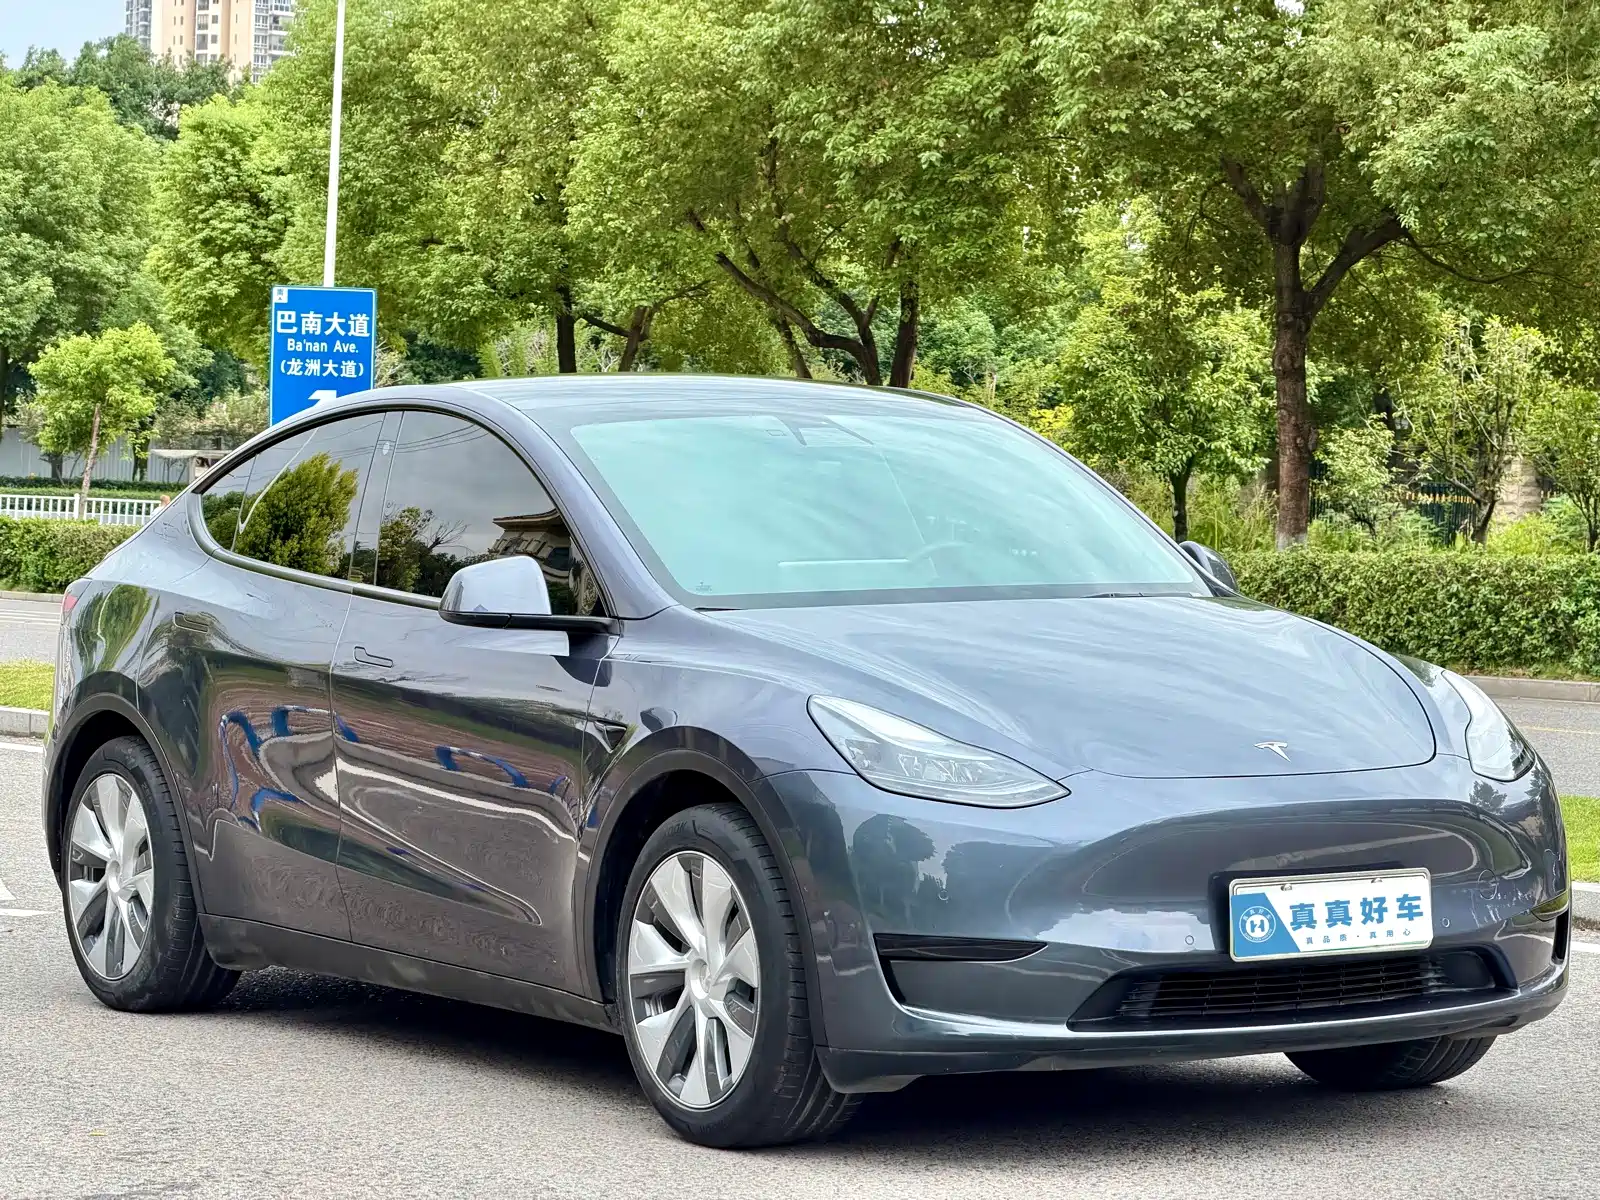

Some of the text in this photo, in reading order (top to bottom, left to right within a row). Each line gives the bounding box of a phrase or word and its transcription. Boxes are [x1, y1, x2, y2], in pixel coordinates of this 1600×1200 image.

[276, 310, 370, 337] 巴南大道
[287, 338, 359, 353] Ba'nan Ave.
[280, 357, 364, 378] (龙洲大道)
[1289, 893, 1424, 931] 真真好车
